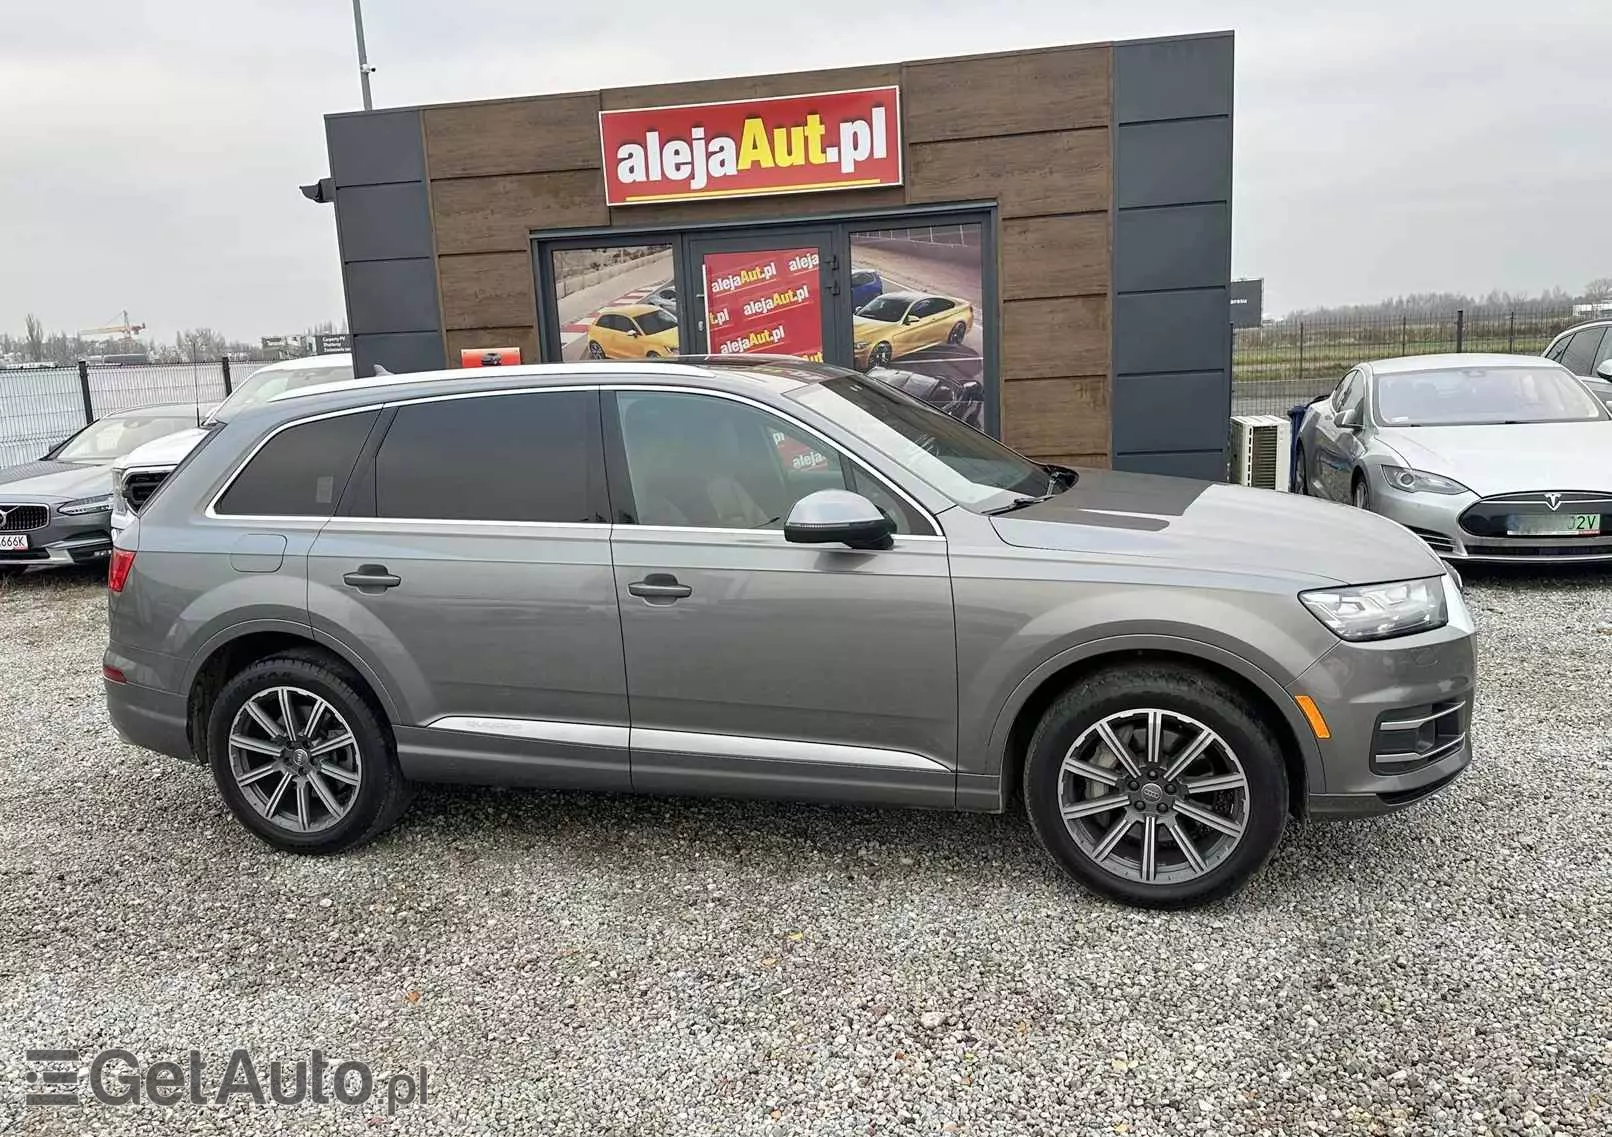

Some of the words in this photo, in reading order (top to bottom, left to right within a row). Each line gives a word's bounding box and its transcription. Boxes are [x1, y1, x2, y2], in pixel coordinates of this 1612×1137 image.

[617, 106, 887, 190] alejaAut.pl
[789, 253, 819, 271] aleja
[711, 262, 777, 292] alejaAut.pl
[743, 285, 809, 315] alejaAut.pl
[720, 325, 785, 354] alejaAut.pl
[0, 536, 24, 547] 666K
